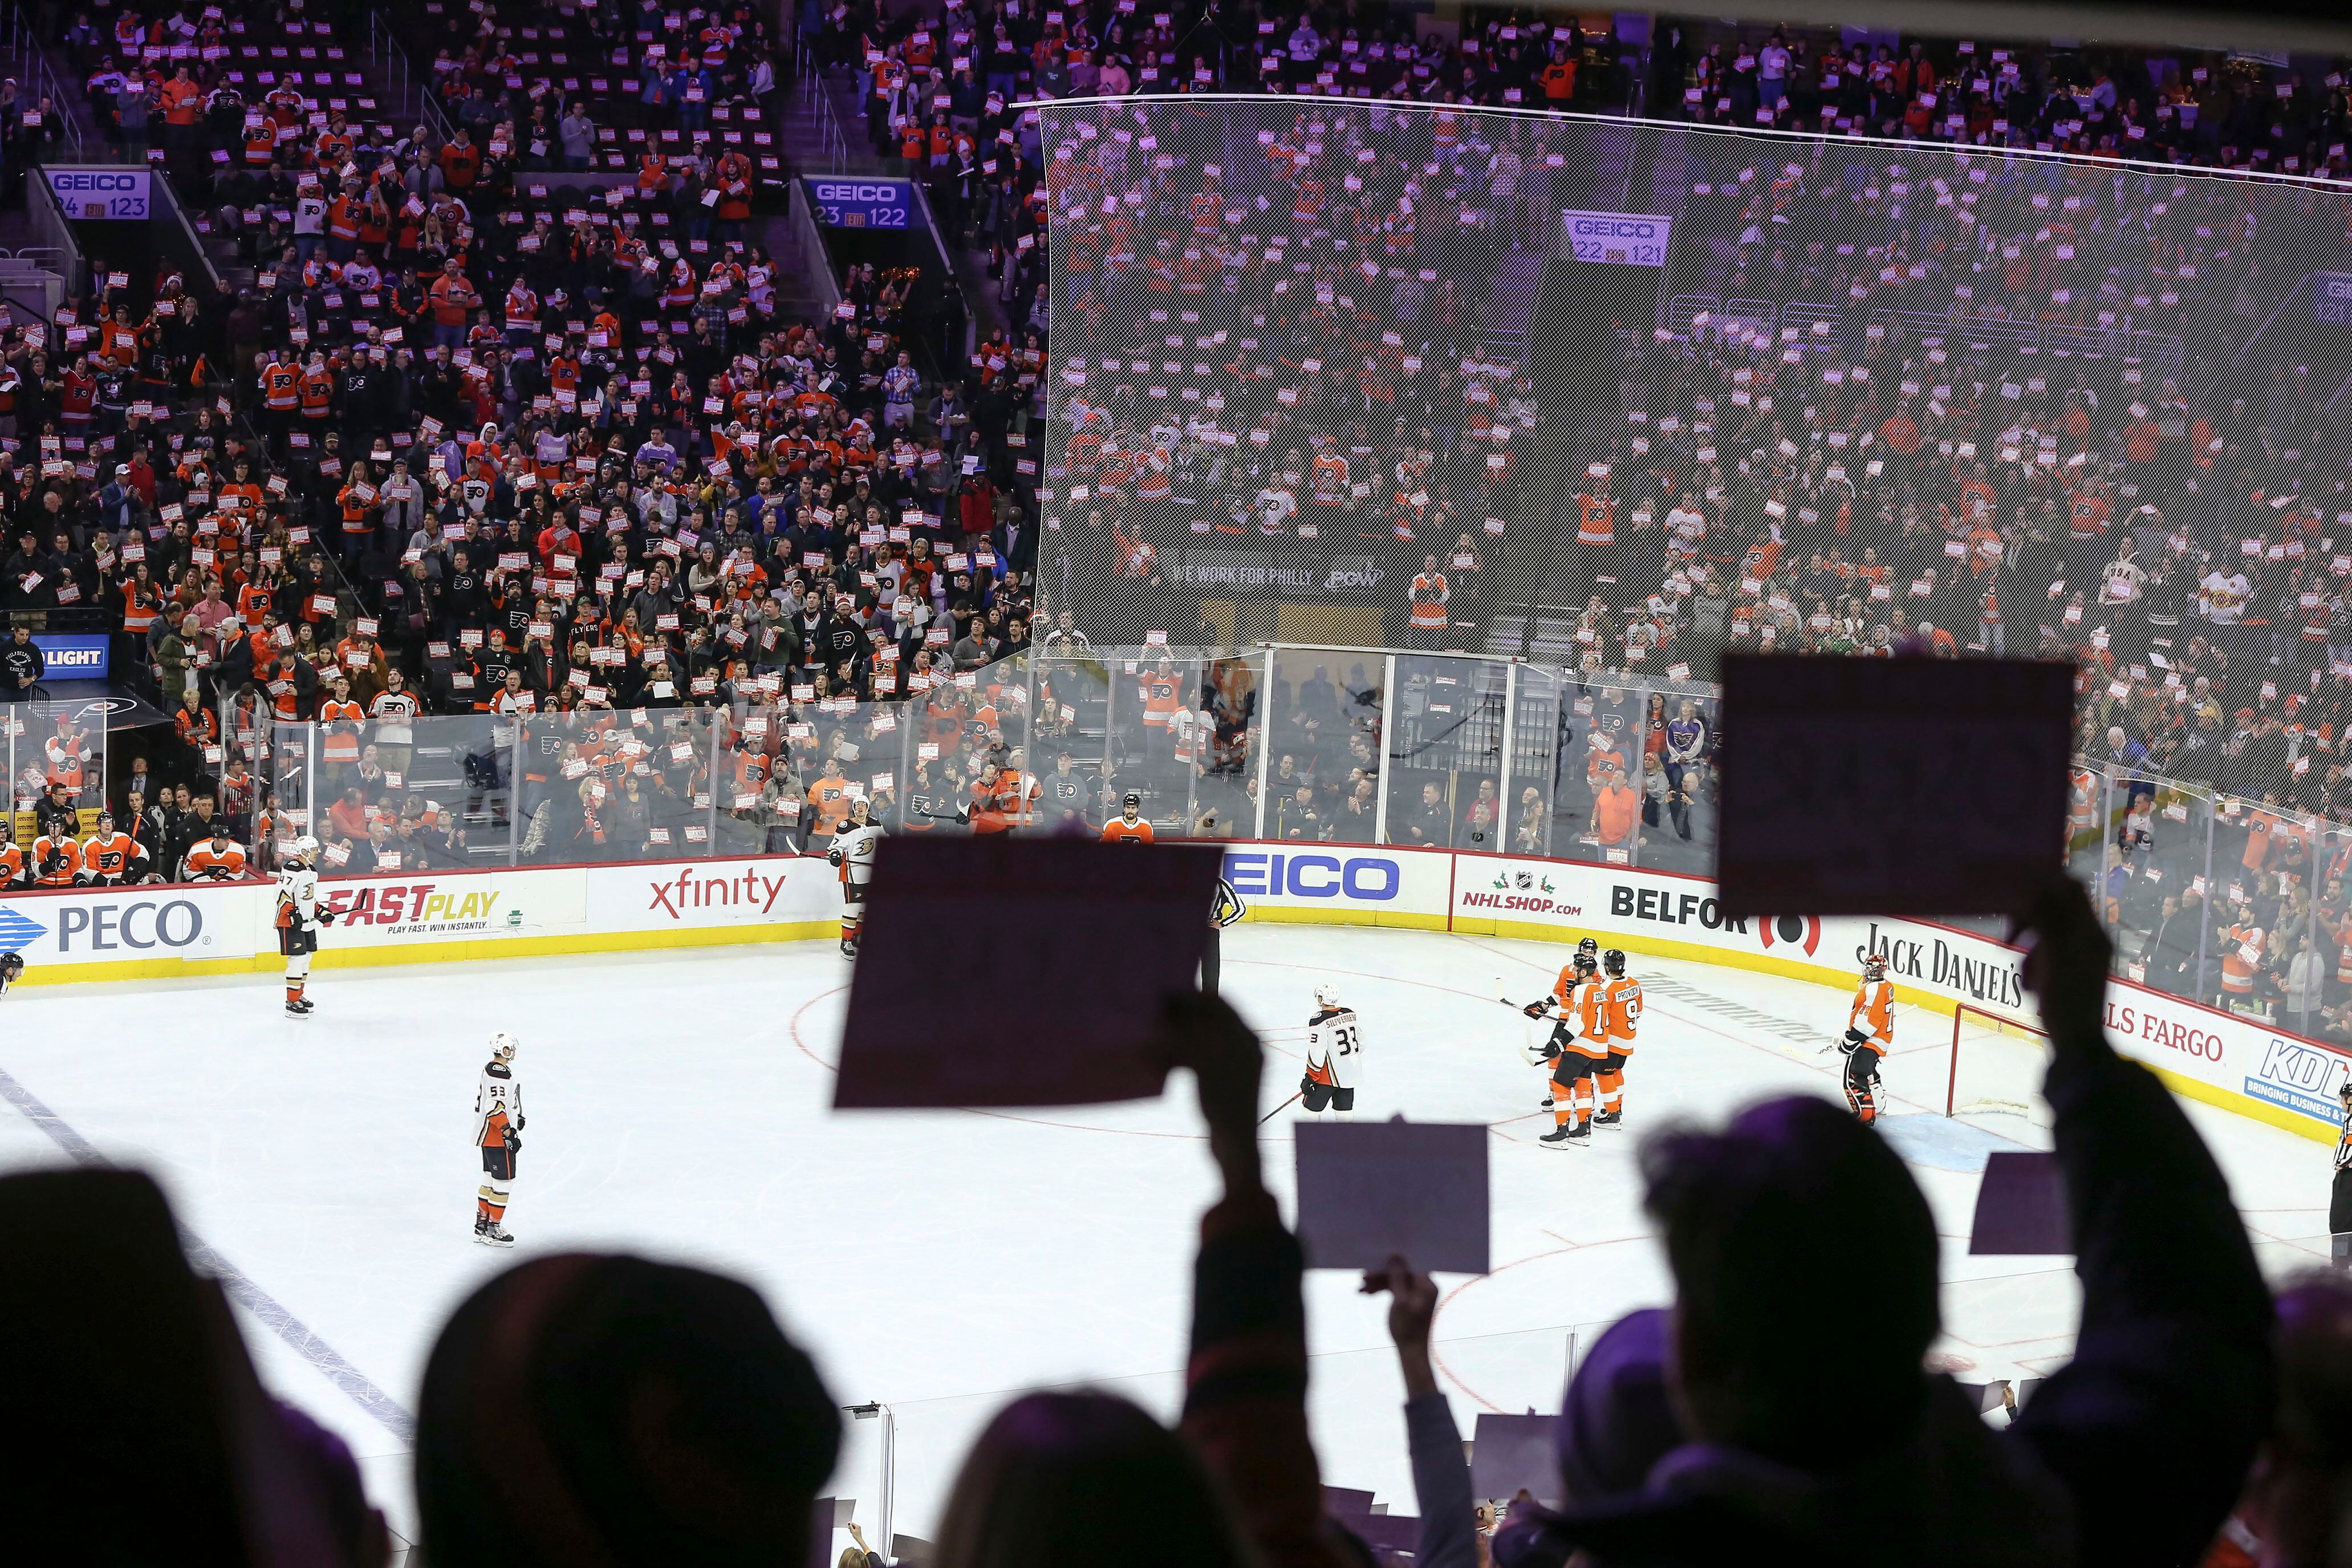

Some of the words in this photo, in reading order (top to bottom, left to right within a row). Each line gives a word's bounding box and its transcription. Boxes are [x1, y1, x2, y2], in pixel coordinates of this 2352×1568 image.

[54, 174, 136, 190] GEICO
[817, 185, 896, 202] GEICO
[88, 205, 103, 216] EXIT
[110, 198, 145, 216] 123
[848, 215, 863, 225] EXIT
[870, 208, 905, 226] 122
[1575, 220, 1655, 238] GEICO
[1575, 241, 1602, 259] 22
[1633, 244, 1661, 262] 121
[124, 549, 144, 557] OSKAR
[1172, 565, 1194, 582] WE
[1196, 566, 1236, 583] WORK
[1240, 567, 1266, 584] FOR
[1269, 568, 1314, 586] PHILLY
[315, 600, 335, 610] OSKAR
[571, 624, 598, 635] FLYERS
[505, 655, 511, 664] C
[882, 650, 899, 659] OSKAR
[571, 675, 589, 683] OSKAR
[279, 875, 293, 885] 47
[1224, 853, 1400, 900] EICO
[1518, 876, 1530, 886] NHL
[649, 867, 787, 919] xfinity
[320, 884, 436, 928] FAST
[423, 891, 501, 921] PLAY
[59, 900, 203, 952] PECO
[448, 921, 488, 931] INSTANTLY.
[1570, 1002, 1582, 1014] 14
[1625, 999, 1638, 1031] 9
[1859, 1005, 1872, 1016] 79
[1884, 1002, 1894, 1033] 7
[1335, 1026, 1359, 1057] 33
[2142, 1014, 2223, 1062] FARGO
[490, 1086, 505, 1097] 53
[2247, 1080, 2289, 1103] BRINGING
[2290, 1094, 2331, 1118] BUSINESS
[2332, 1110, 2339, 1121] &
